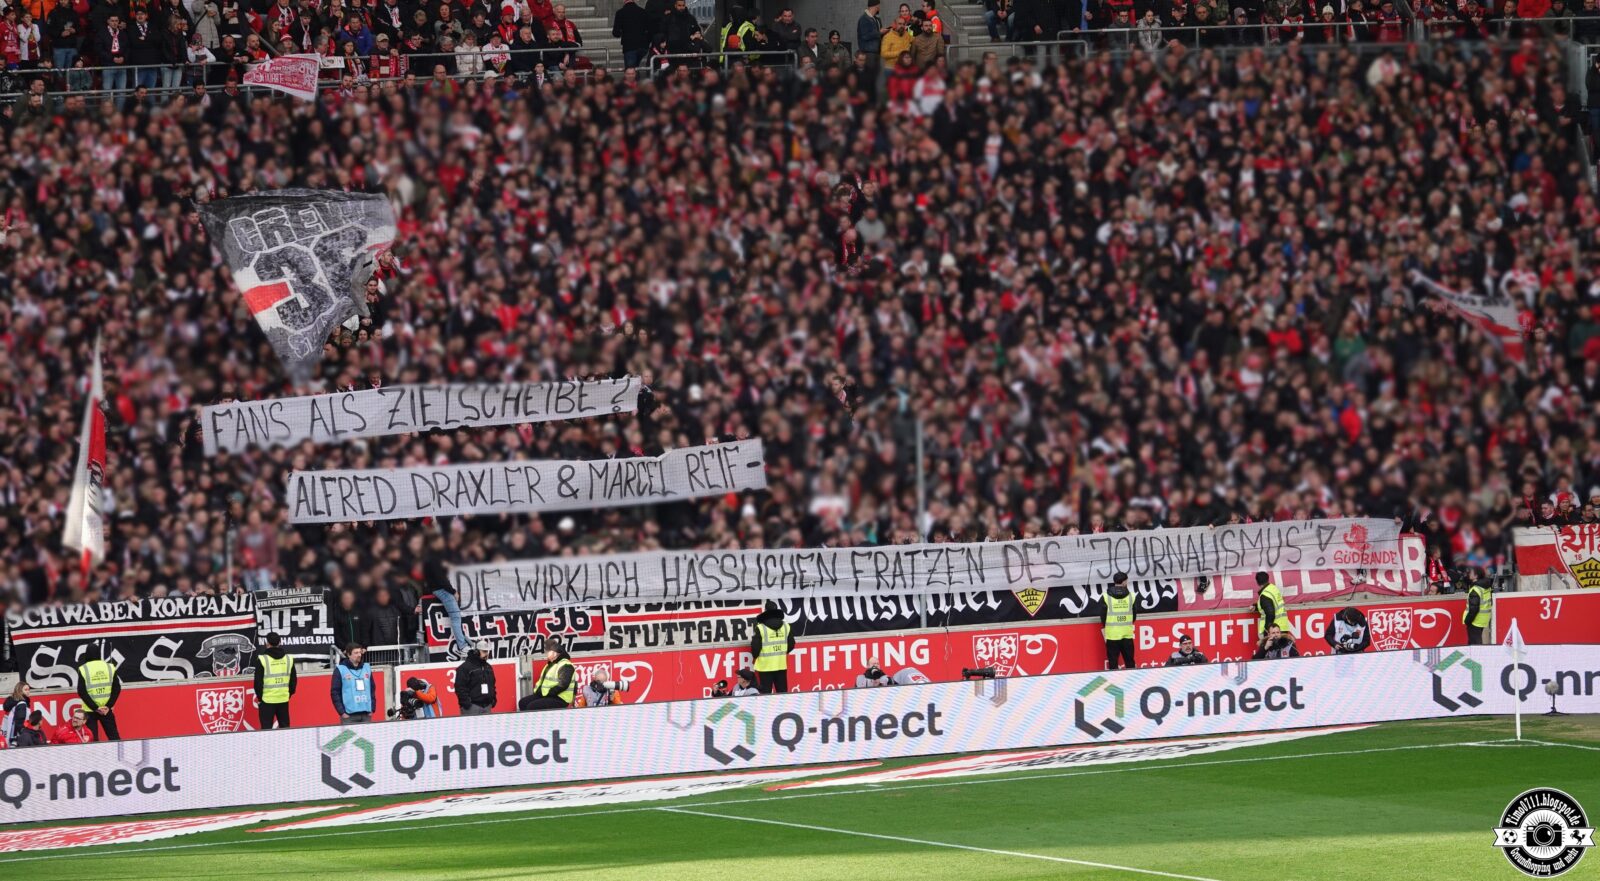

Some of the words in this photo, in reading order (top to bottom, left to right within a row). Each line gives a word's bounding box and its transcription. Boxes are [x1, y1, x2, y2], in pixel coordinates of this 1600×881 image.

[211, 401, 291, 449] FANS
[309, 393, 367, 437] ALS
[377, 380, 597, 430] ZIELSCHEIBE
[295, 474, 397, 518] ALFRED
[410, 465, 546, 510] DRAXLER
[556, 464, 580, 500] &
[588, 459, 679, 500] MARCEL
[685, 445, 739, 492] REIF
[456, 568, 501, 611] DIE
[514, 560, 640, 602] WIRKLICH
[661, 552, 838, 599] HÄSSLICHEN
[851, 545, 985, 592] FRATZEN
[1003, 540, 1066, 584] DES
[1333, 550, 1398, 565] SÜDBANDE
[5, 599, 144, 628] SCHWABEN
[257, 603, 335, 636] 50+1
[545, 606, 592, 632] 36
[1540, 597, 1563, 620] 37
[1139, 677, 1305, 726] Q-nnect
[771, 703, 944, 752] Q-nnect
[391, 729, 569, 780] Q-nnect
[0, 757, 181, 809] Q-nnect
